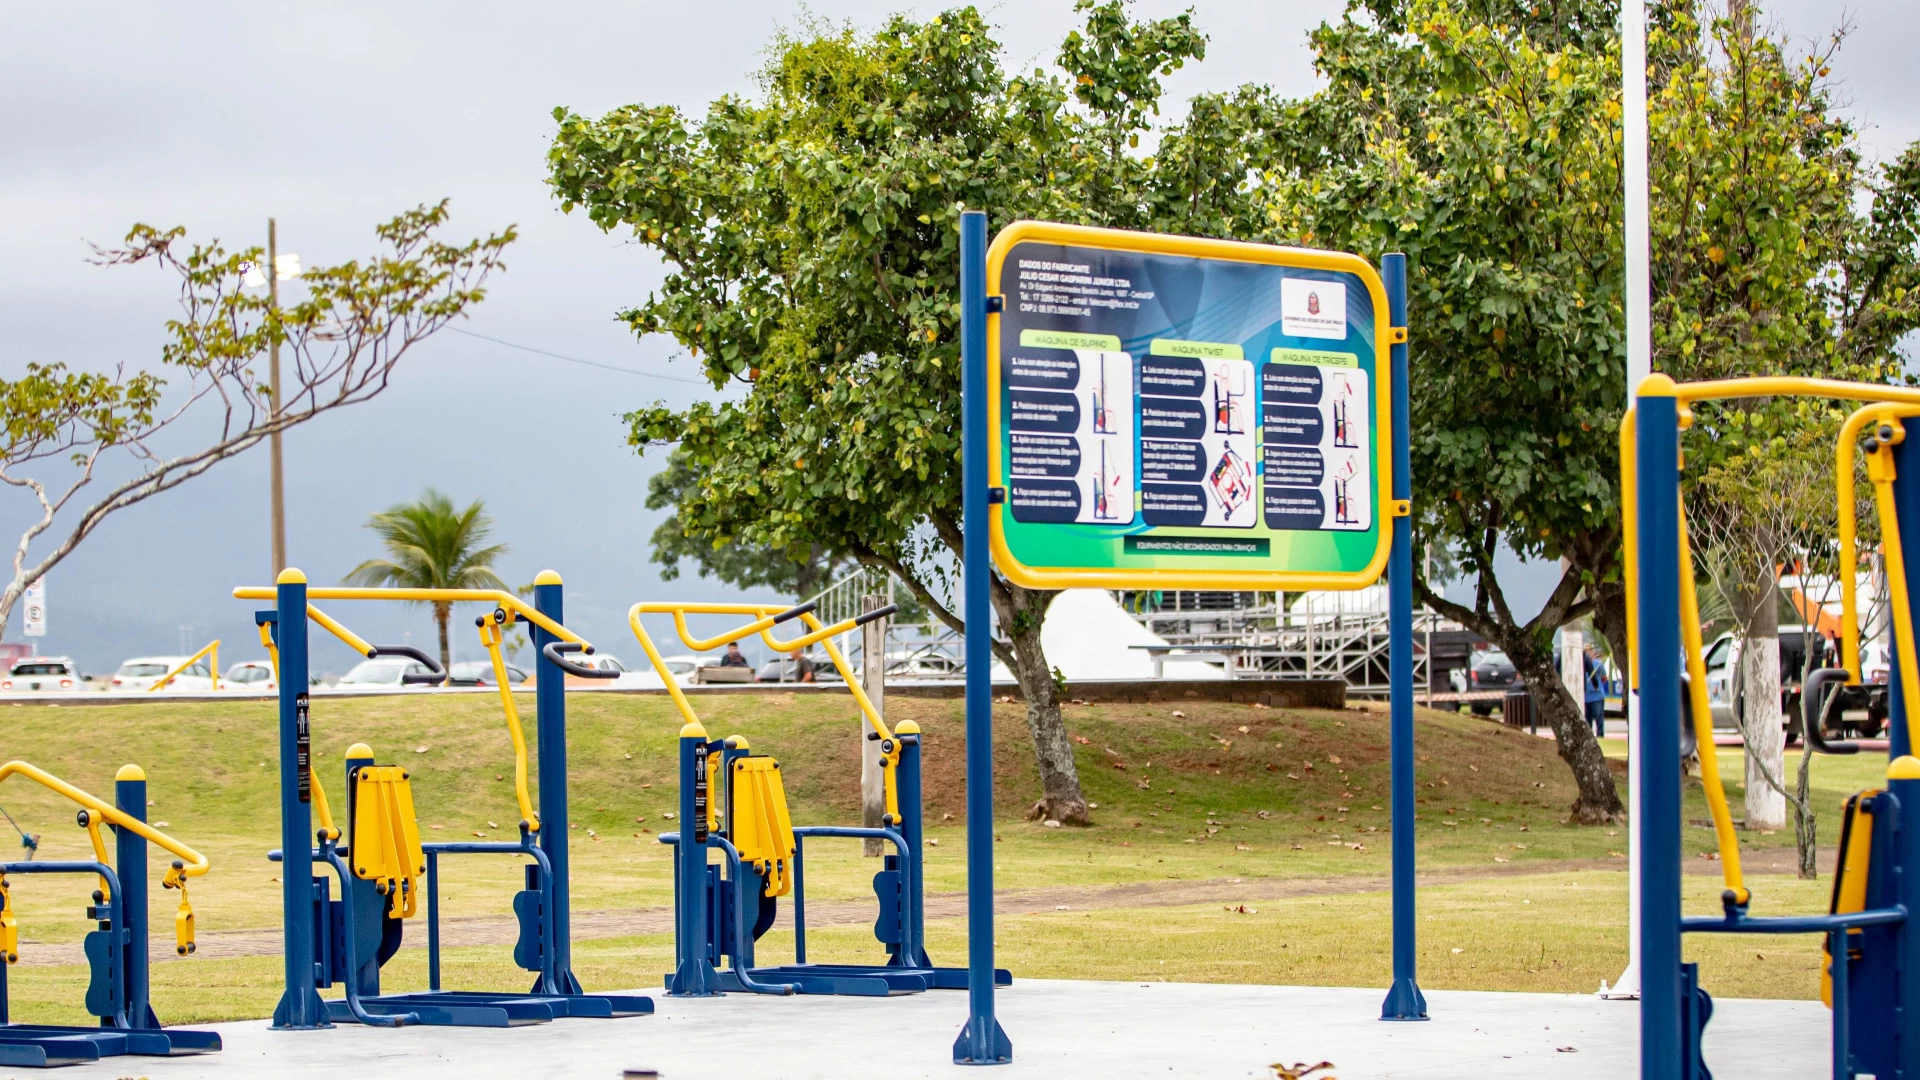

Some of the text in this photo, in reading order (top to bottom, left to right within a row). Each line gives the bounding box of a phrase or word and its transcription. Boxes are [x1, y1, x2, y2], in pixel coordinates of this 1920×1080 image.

[1019, 259, 1090, 274] DADOS DO FABRICANTE
[1019, 271, 1131, 288] JULIO CESAR GASPARINI JUNIOR LTDA
